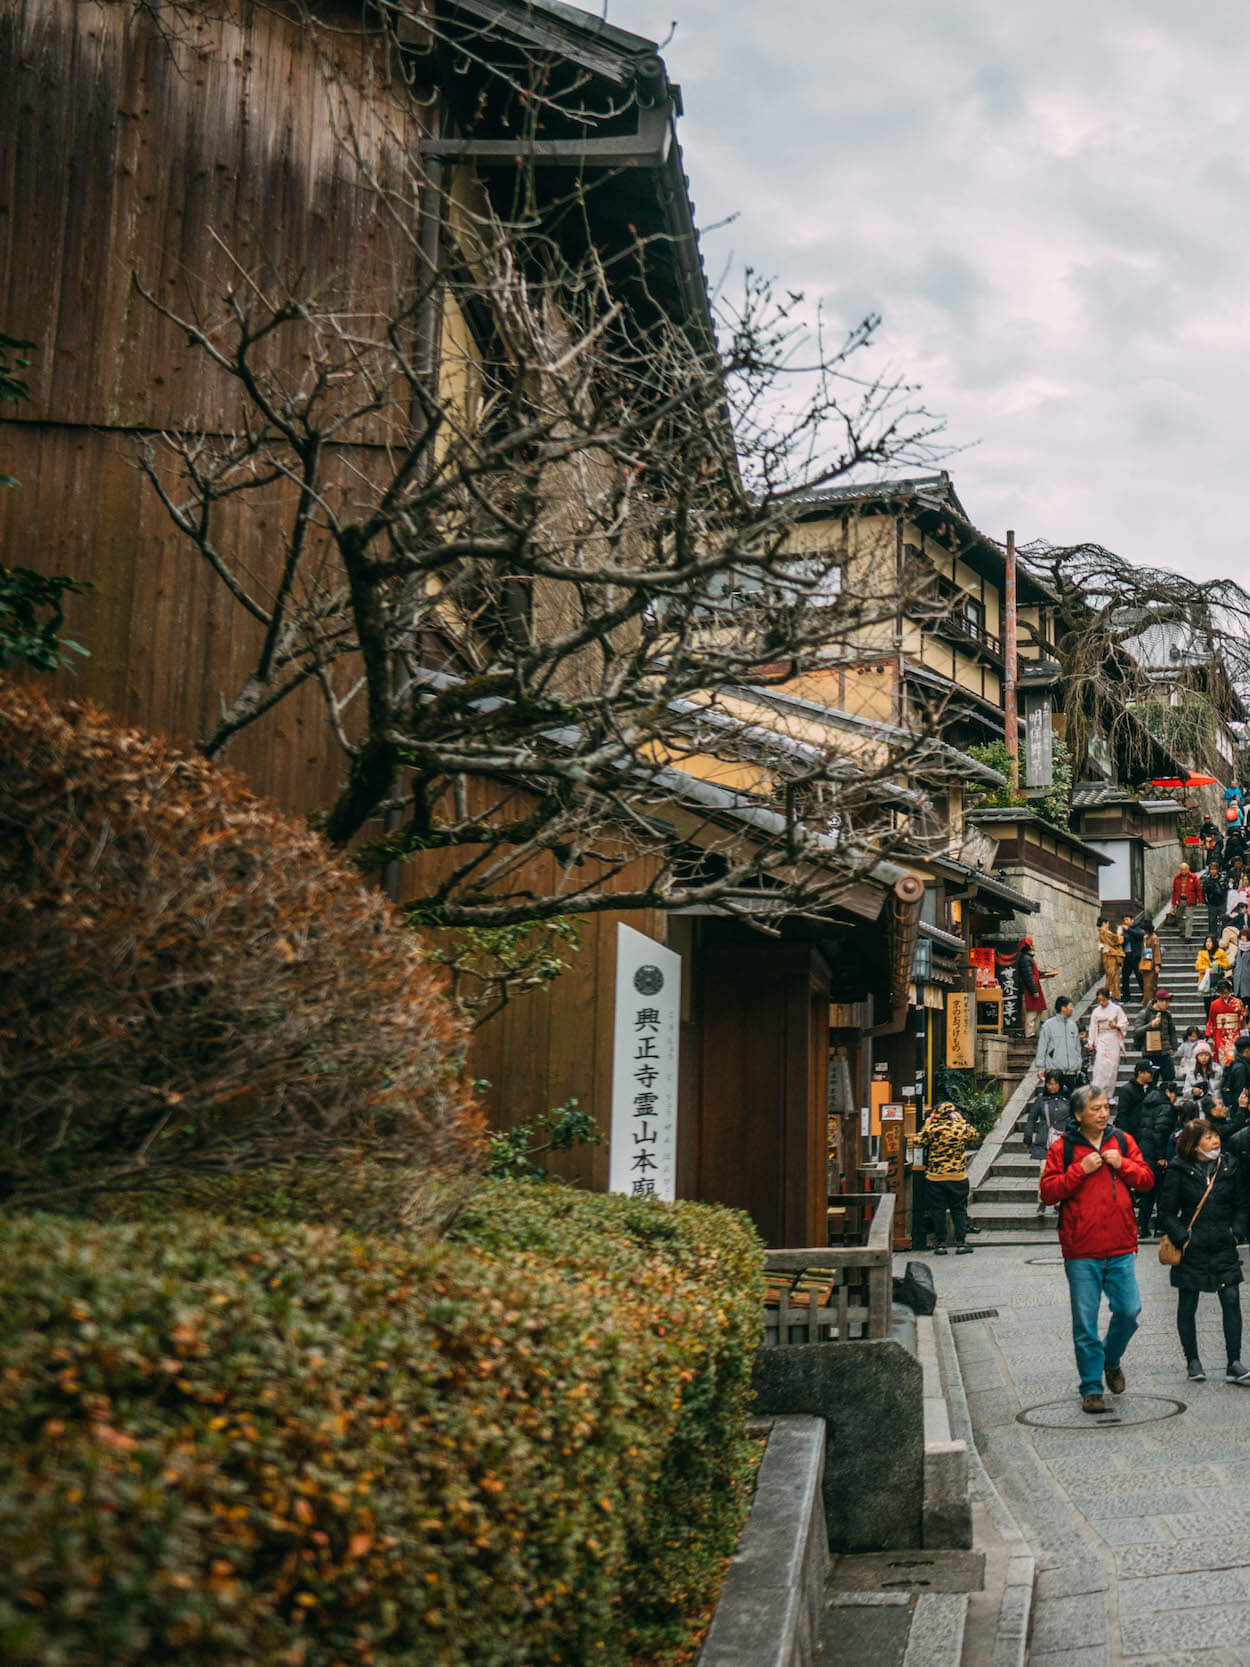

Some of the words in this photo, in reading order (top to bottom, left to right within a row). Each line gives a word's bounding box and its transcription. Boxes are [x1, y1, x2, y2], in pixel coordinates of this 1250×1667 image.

[630, 1007, 662, 1198] 興正寺霊山本廟
